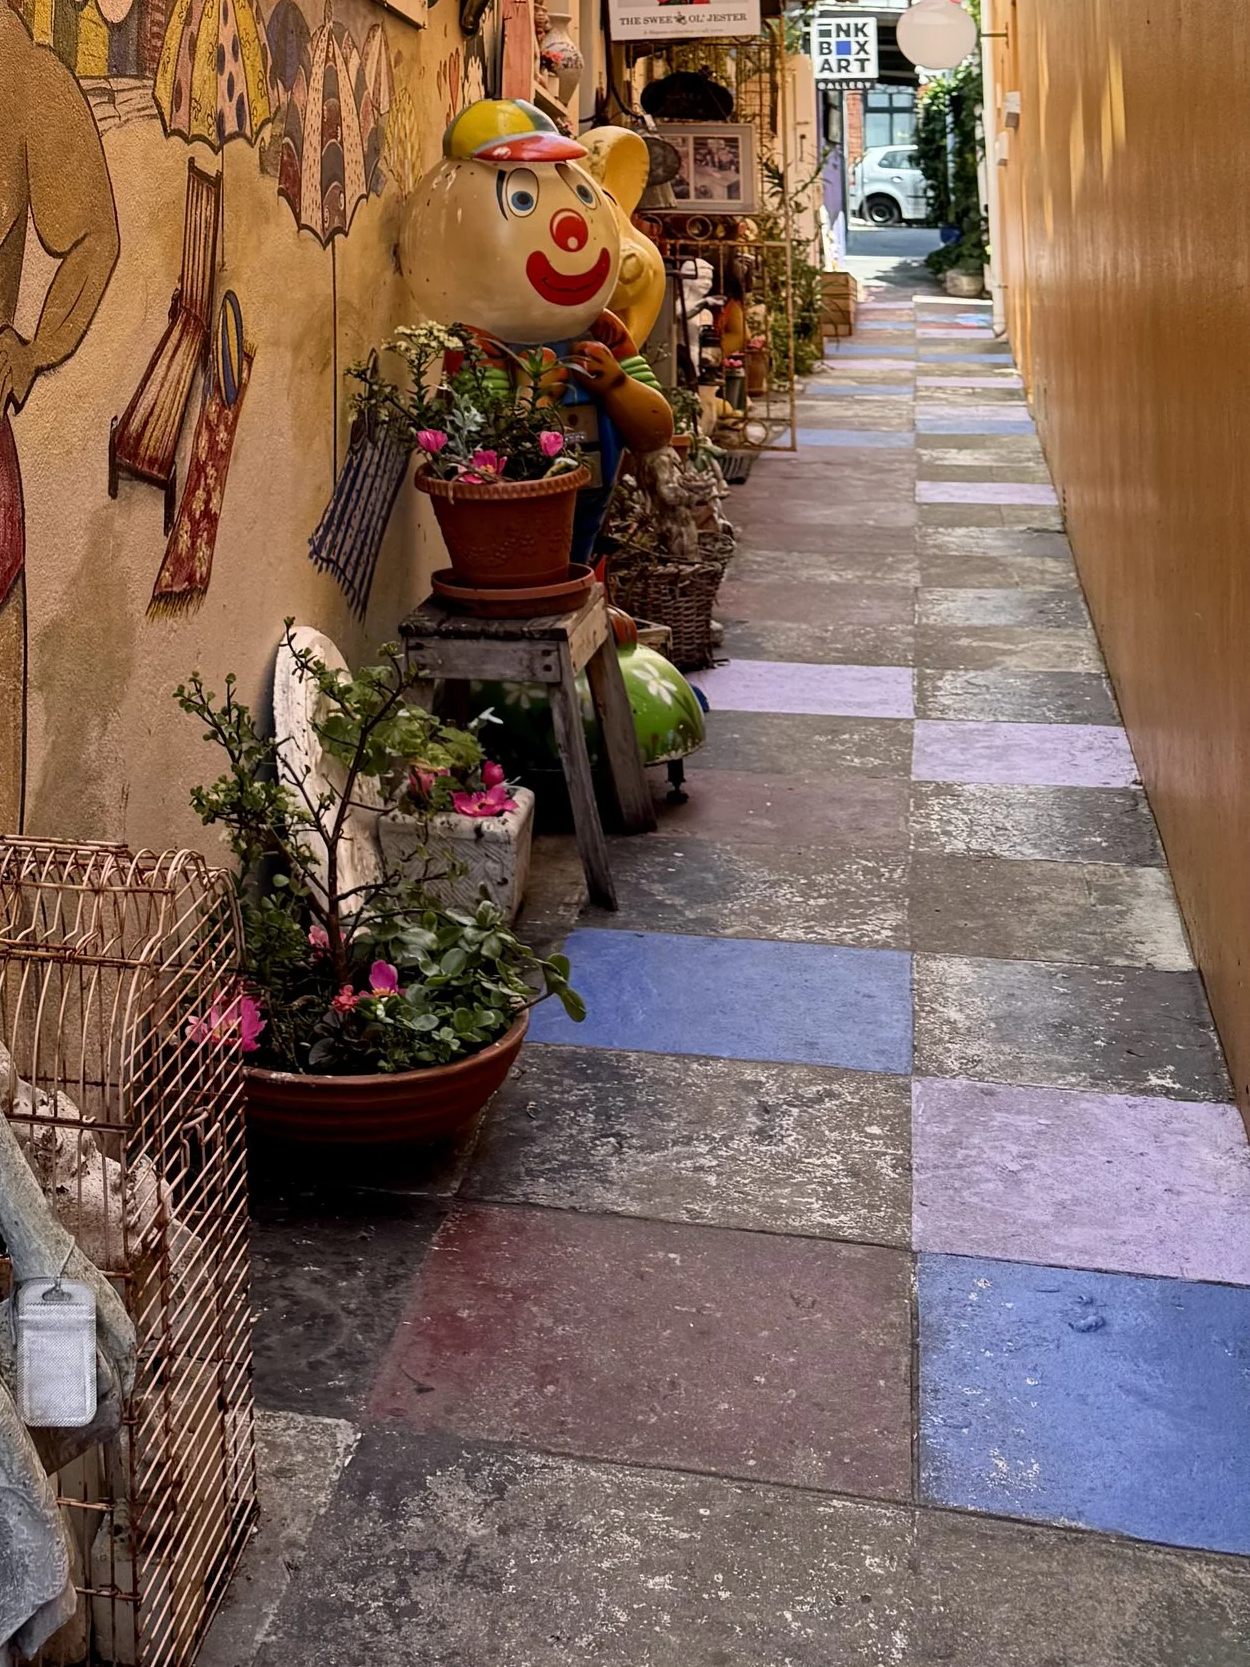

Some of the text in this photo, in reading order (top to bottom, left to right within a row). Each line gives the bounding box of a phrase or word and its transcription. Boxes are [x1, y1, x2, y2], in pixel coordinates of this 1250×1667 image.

[619, 17, 642, 26] THE
[707, 12, 747, 22] JESTER
[819, 58, 871, 73] ART
[817, 81, 871, 90] GALLERY
